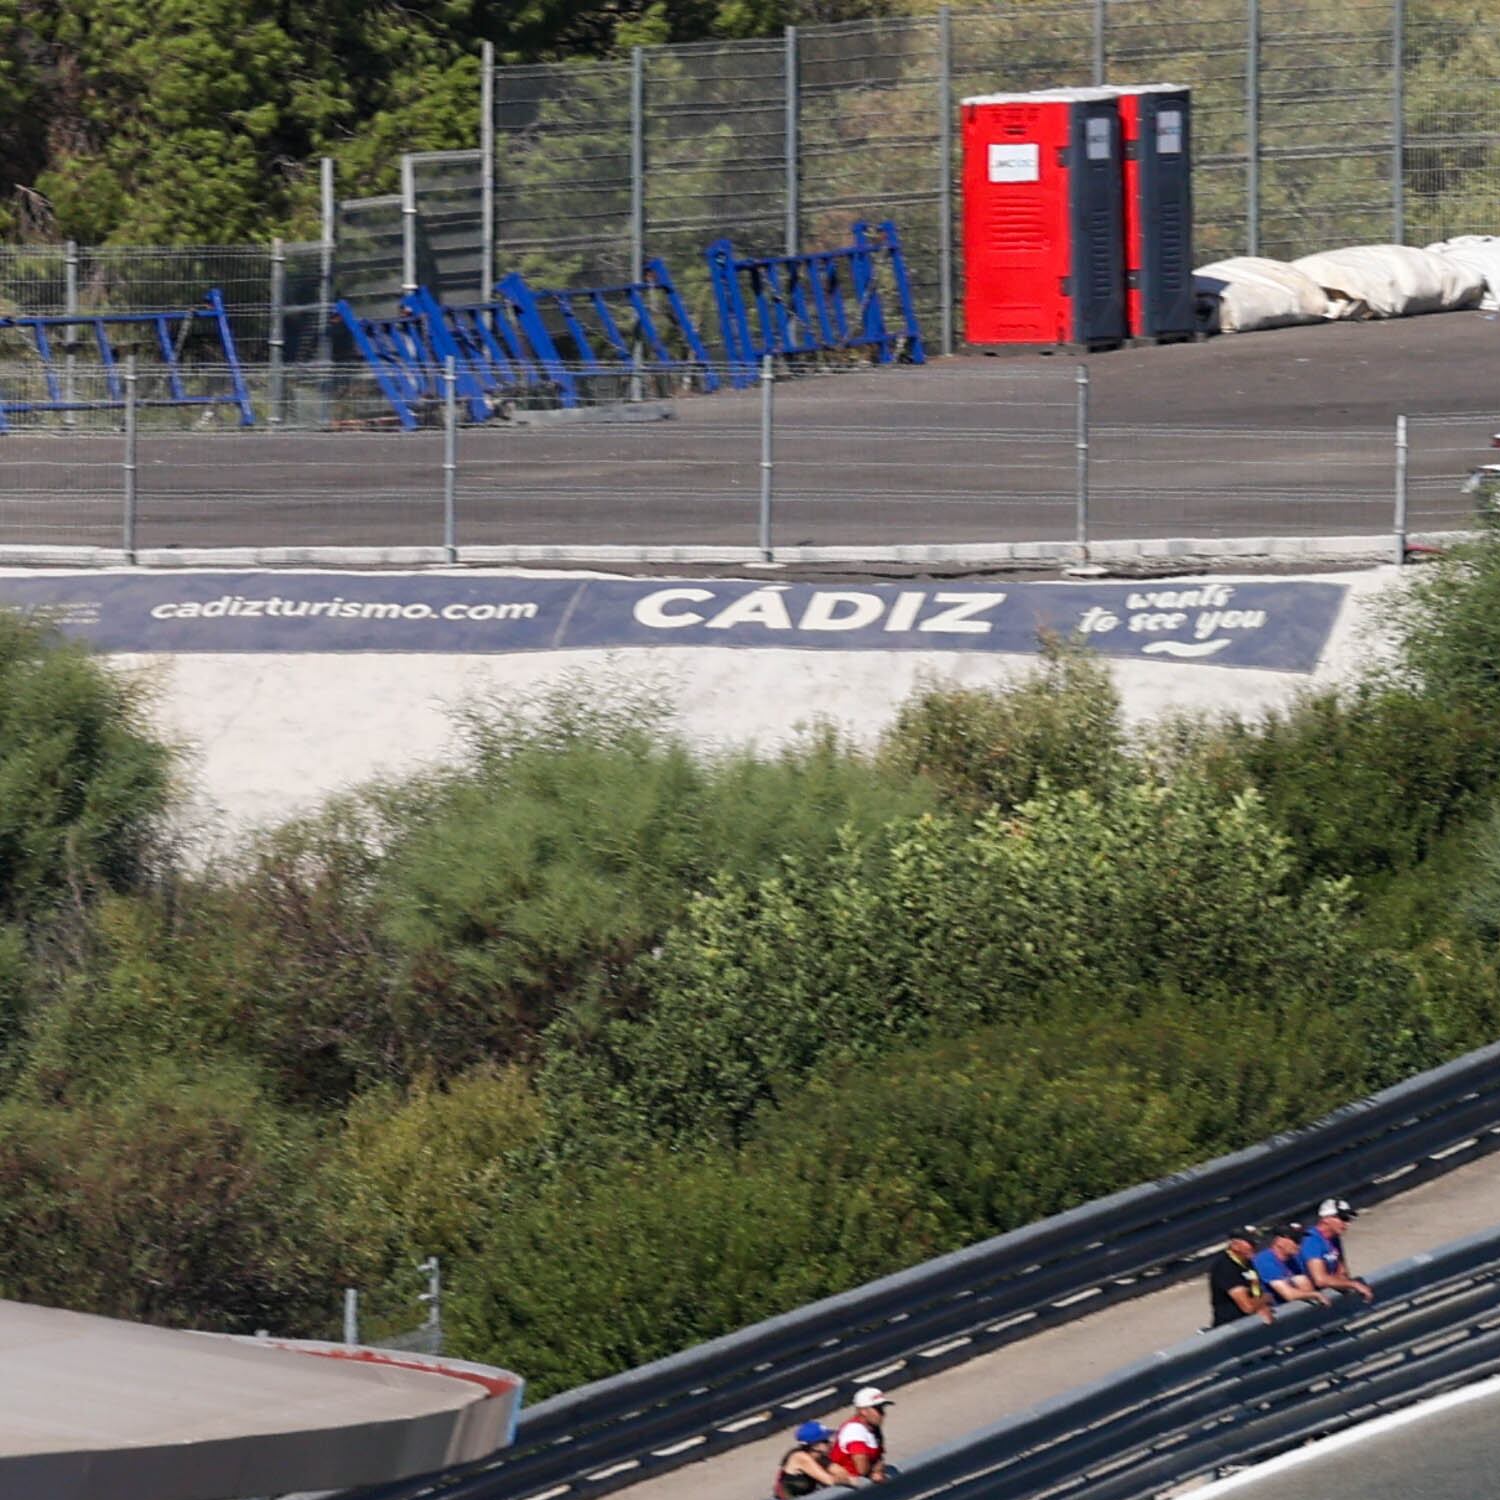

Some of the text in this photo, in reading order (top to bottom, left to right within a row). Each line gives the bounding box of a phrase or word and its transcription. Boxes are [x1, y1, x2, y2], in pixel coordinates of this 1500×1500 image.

[151, 595, 538, 620] cadizturismo.com
[633, 585, 1007, 633] CÁDIZ
[1125, 584, 1236, 609] wants
[1079, 606, 1267, 639] to see you
